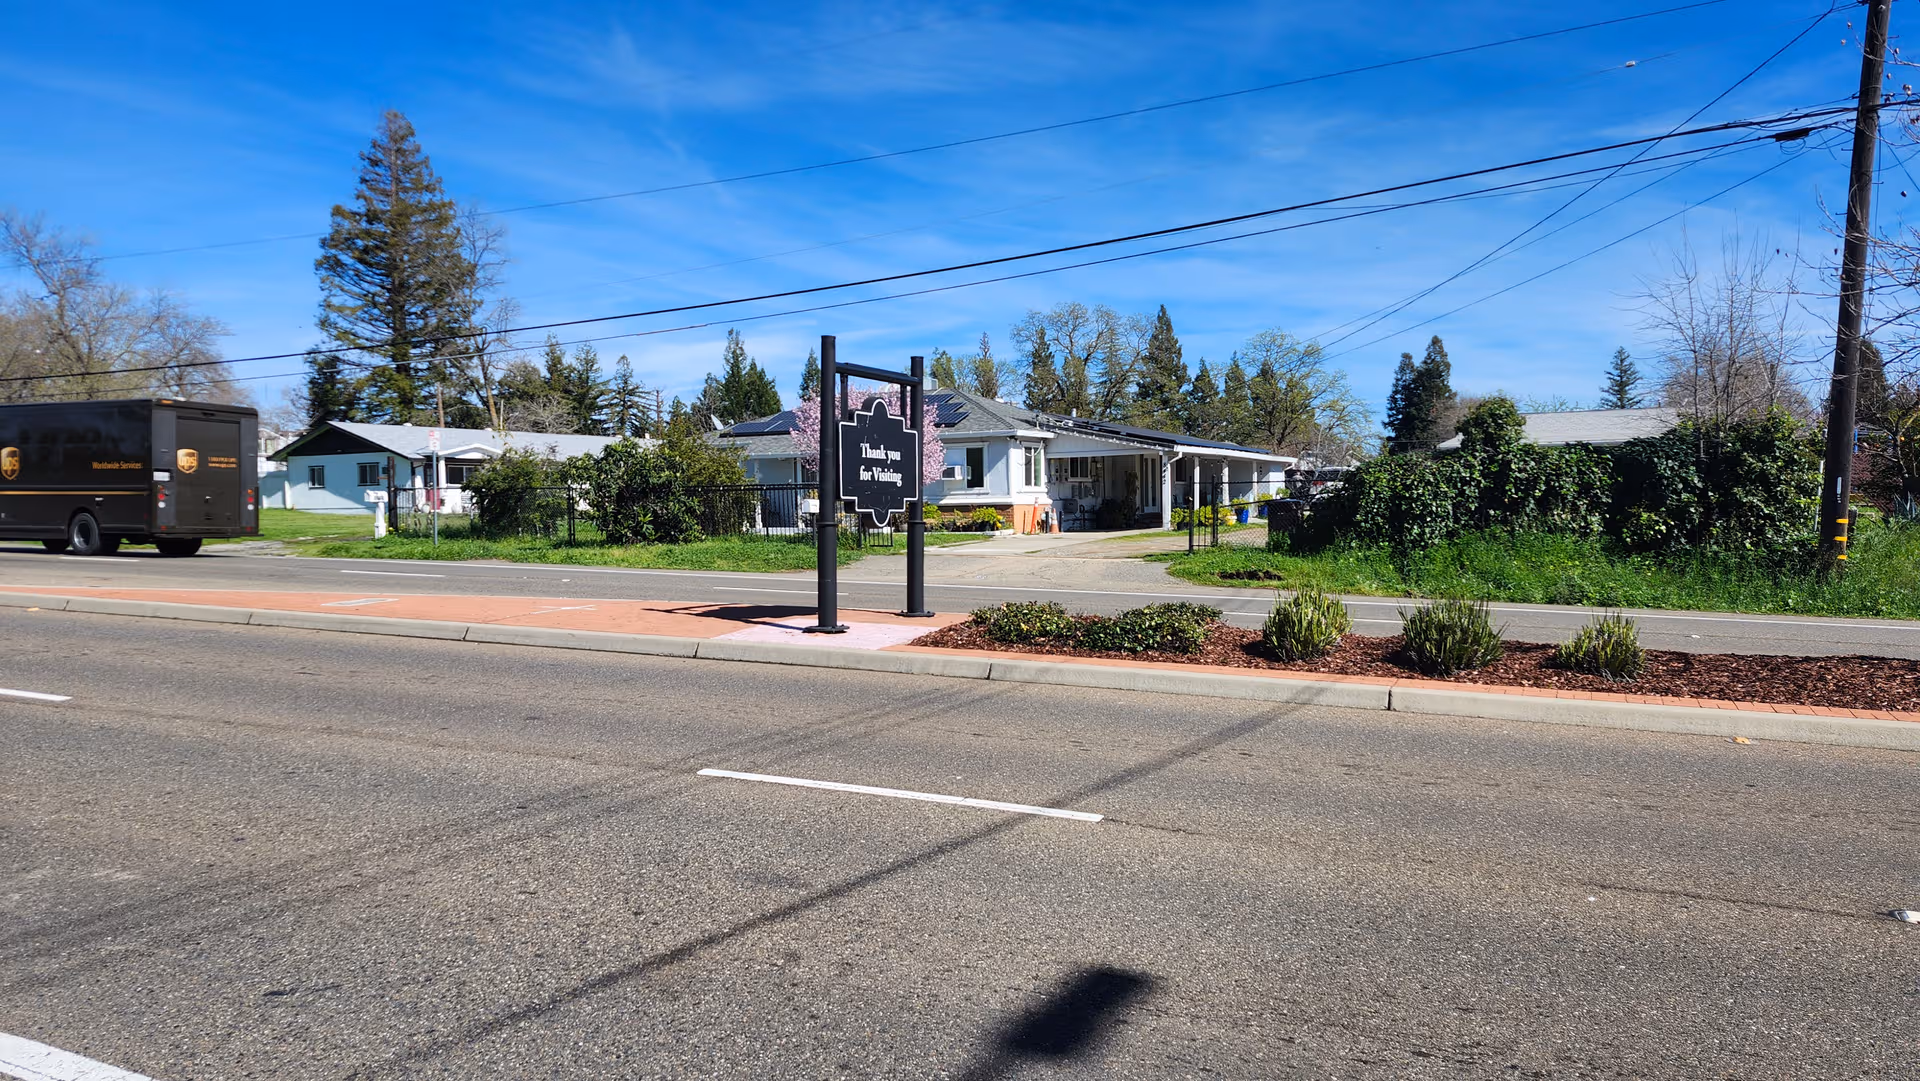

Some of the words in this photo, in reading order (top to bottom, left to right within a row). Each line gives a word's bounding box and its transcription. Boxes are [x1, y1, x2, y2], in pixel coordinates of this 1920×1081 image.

[860, 443, 886, 459] Thank
[887, 450, 901, 464] you
[92, 461, 120, 469] Worldwide
[860, 465, 872, 481] for
[872, 467, 902, 487] Visiting
